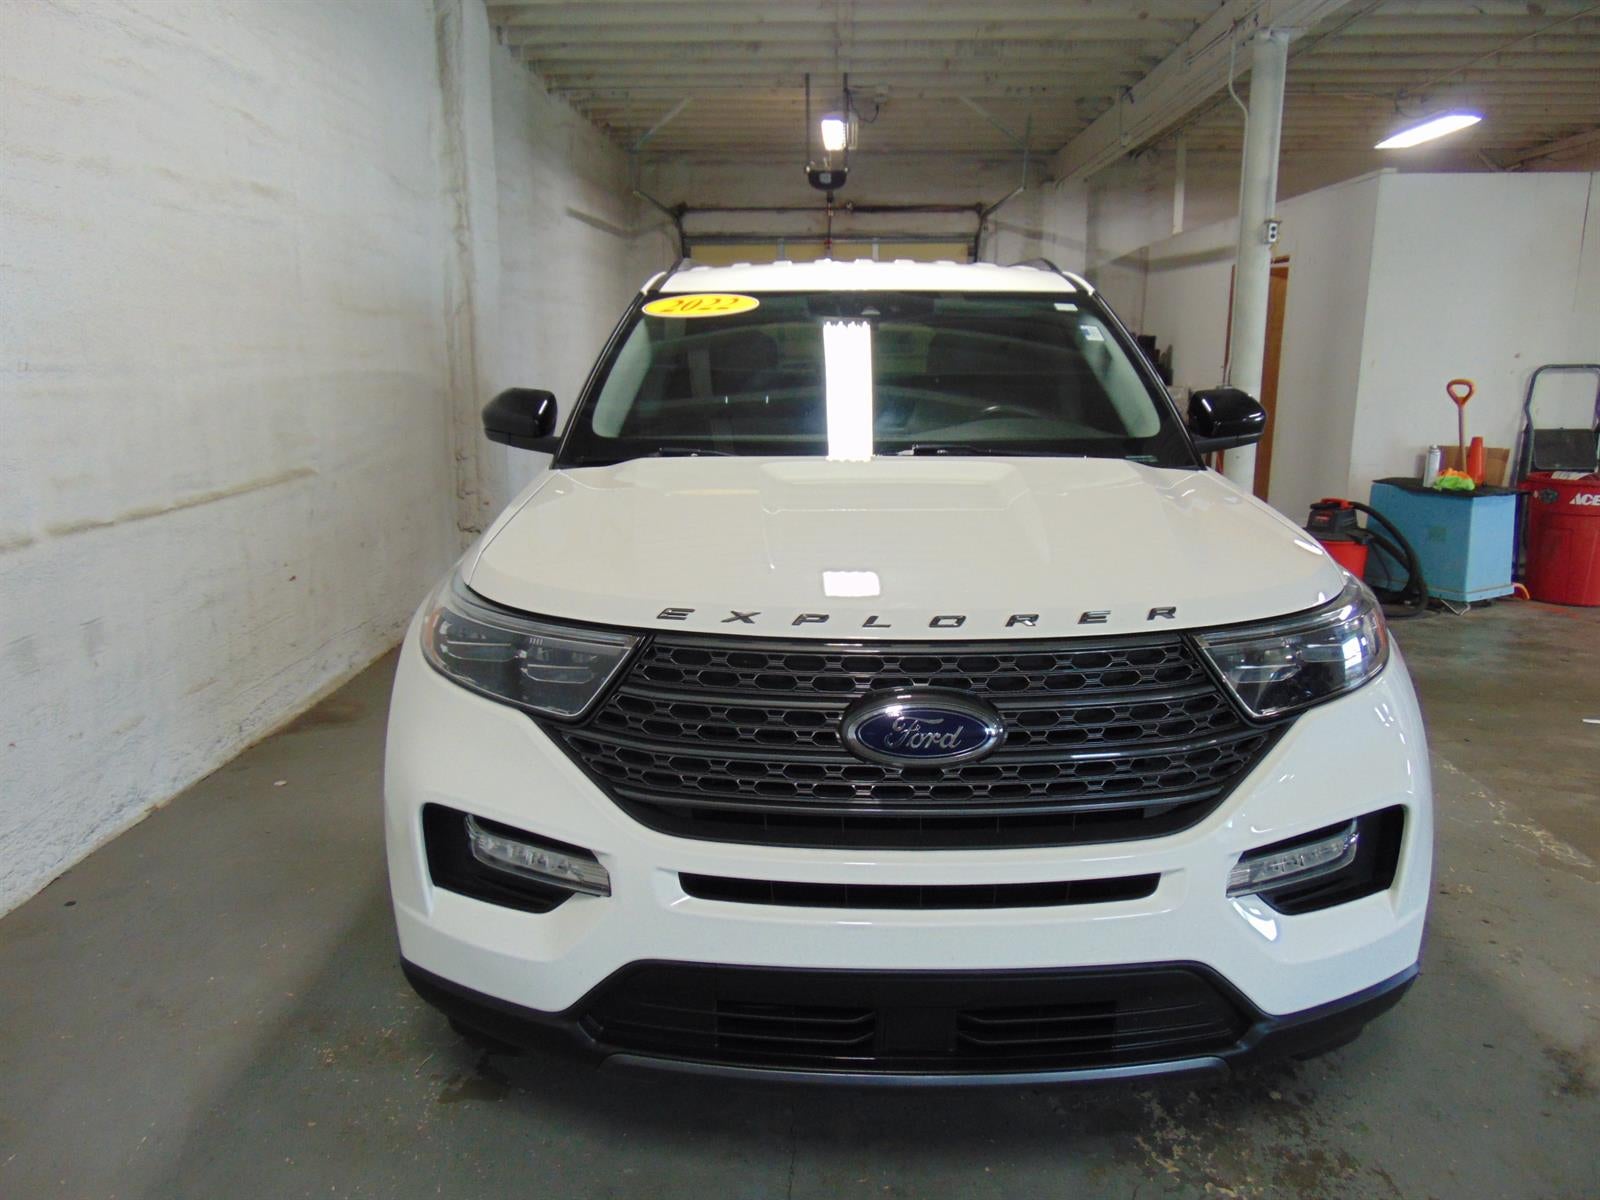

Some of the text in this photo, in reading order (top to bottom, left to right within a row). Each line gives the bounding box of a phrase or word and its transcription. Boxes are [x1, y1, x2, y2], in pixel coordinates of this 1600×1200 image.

[660, 298, 739, 313] 2022
[1569, 492, 1600, 506] ACE
[656, 606, 1177, 629] EXPLORER
[884, 716, 964, 749] Ford
